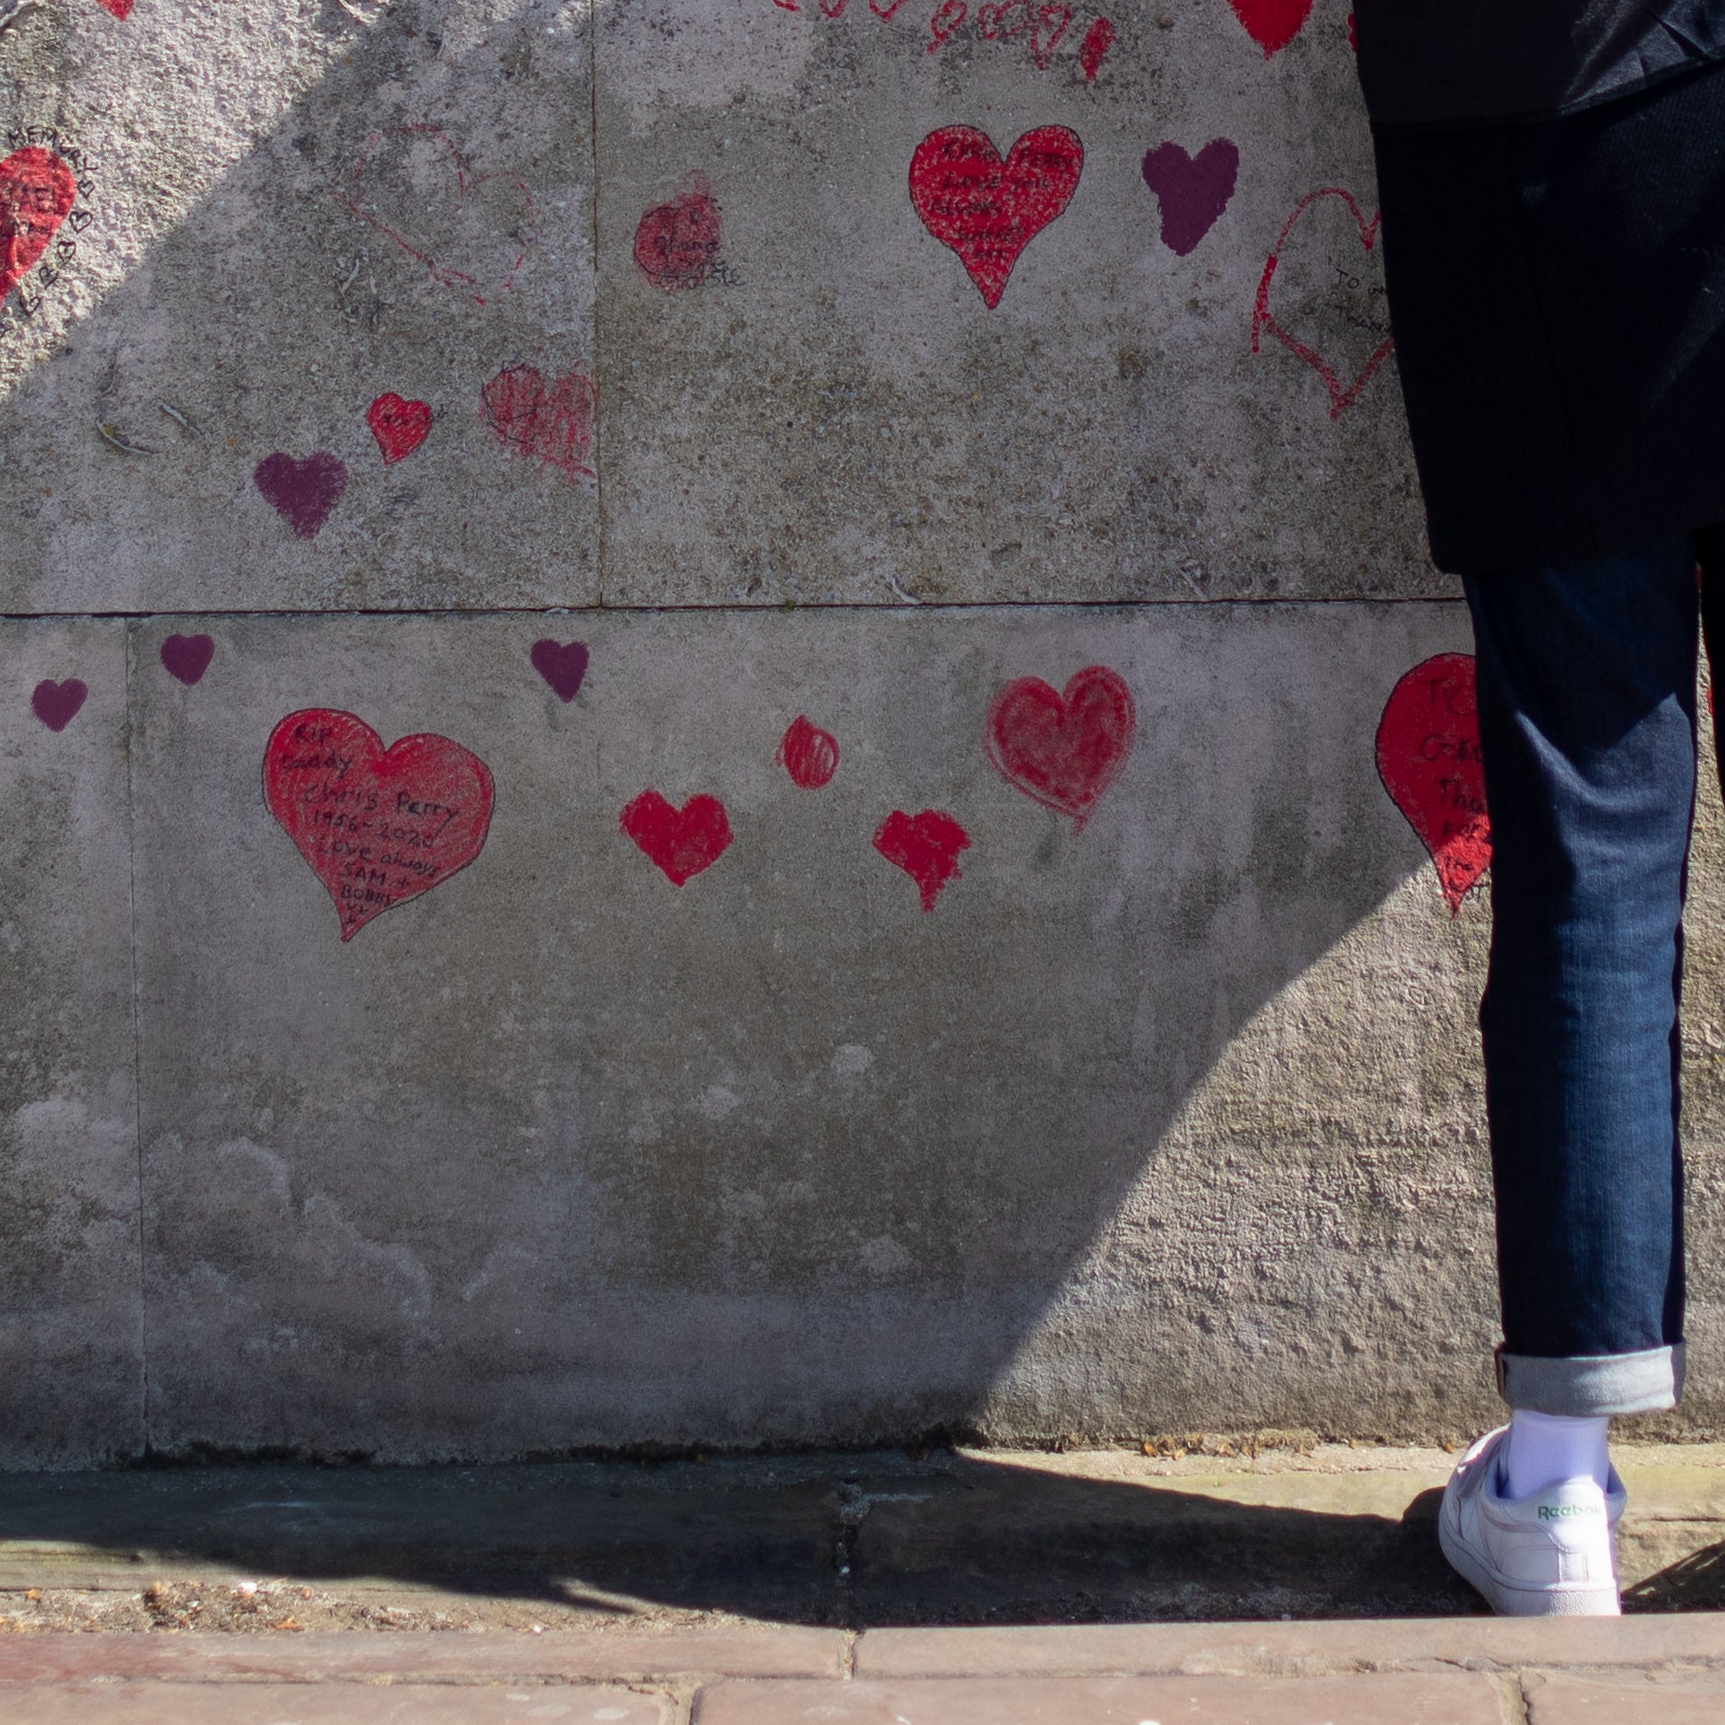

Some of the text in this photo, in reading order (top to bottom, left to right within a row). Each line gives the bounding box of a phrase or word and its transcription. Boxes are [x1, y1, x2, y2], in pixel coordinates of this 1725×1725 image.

[8, 124, 98, 177] MEMORY
[302, 784, 460, 835] Chris Perry
[1537, 1504, 1602, 1521] Reebok
